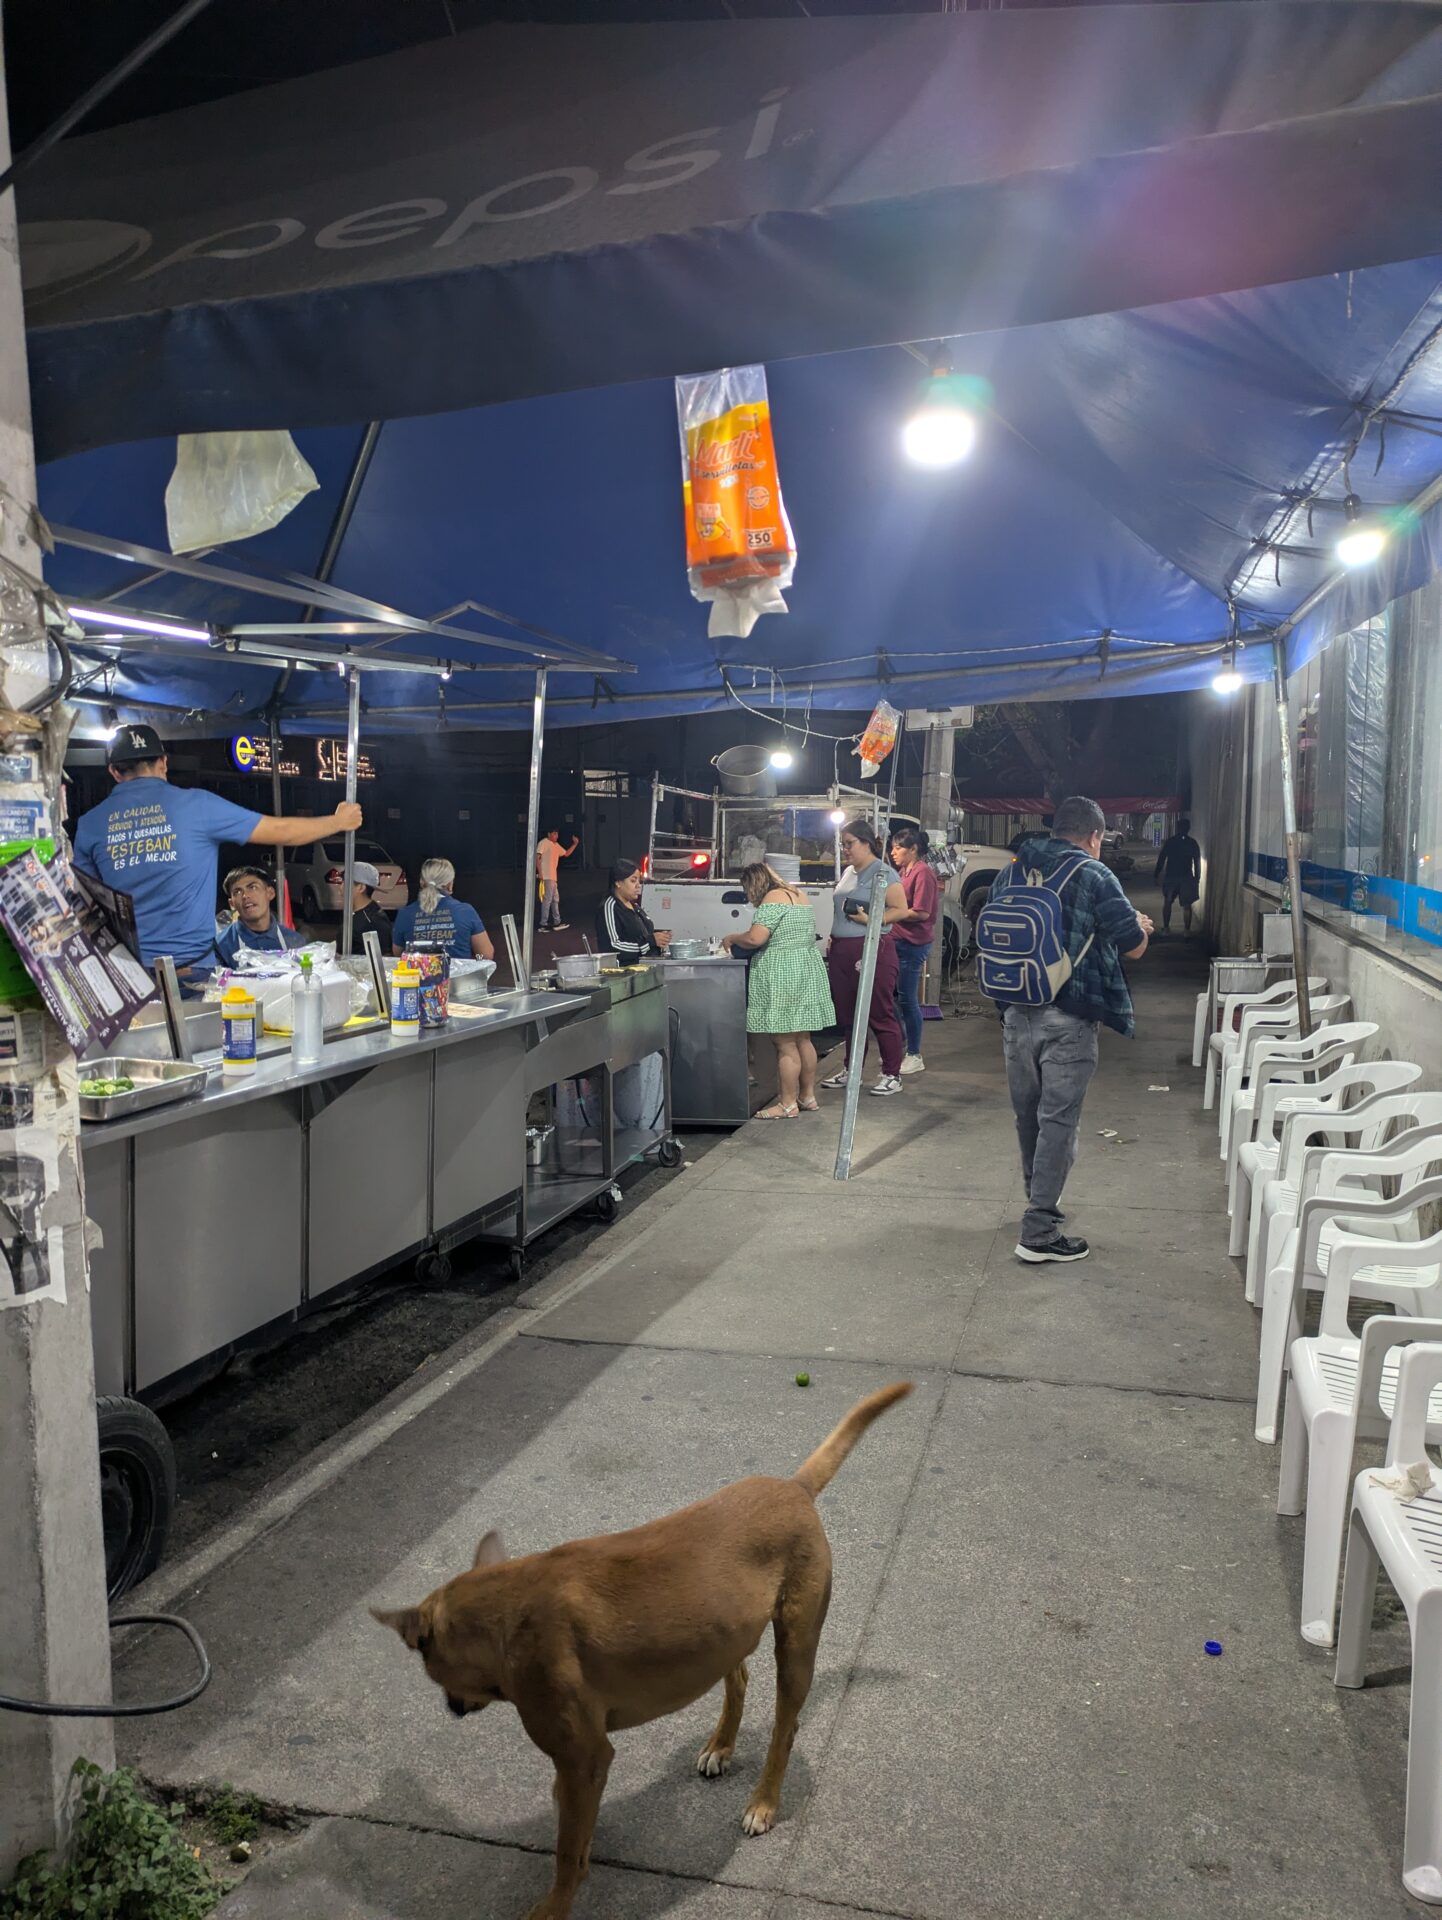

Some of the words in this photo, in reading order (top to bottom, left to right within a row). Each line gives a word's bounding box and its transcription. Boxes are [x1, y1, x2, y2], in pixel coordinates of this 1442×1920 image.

[129, 86, 790, 284] pepsi
[748, 532, 771, 545] 250
[129, 731, 147, 748] LA
[108, 811, 120, 822] EN
[107, 832, 126, 844] TACOS
[128, 831, 132, 840] Y
[134, 824, 172, 839] QUESADILLAS
[108, 820, 133, 833] SERVICIO
[107, 834, 177, 860] "ESTEBAN"
[114, 859, 126, 871] ES
[129, 856, 141, 867] EL
[145, 850, 177, 863] MEJOR
